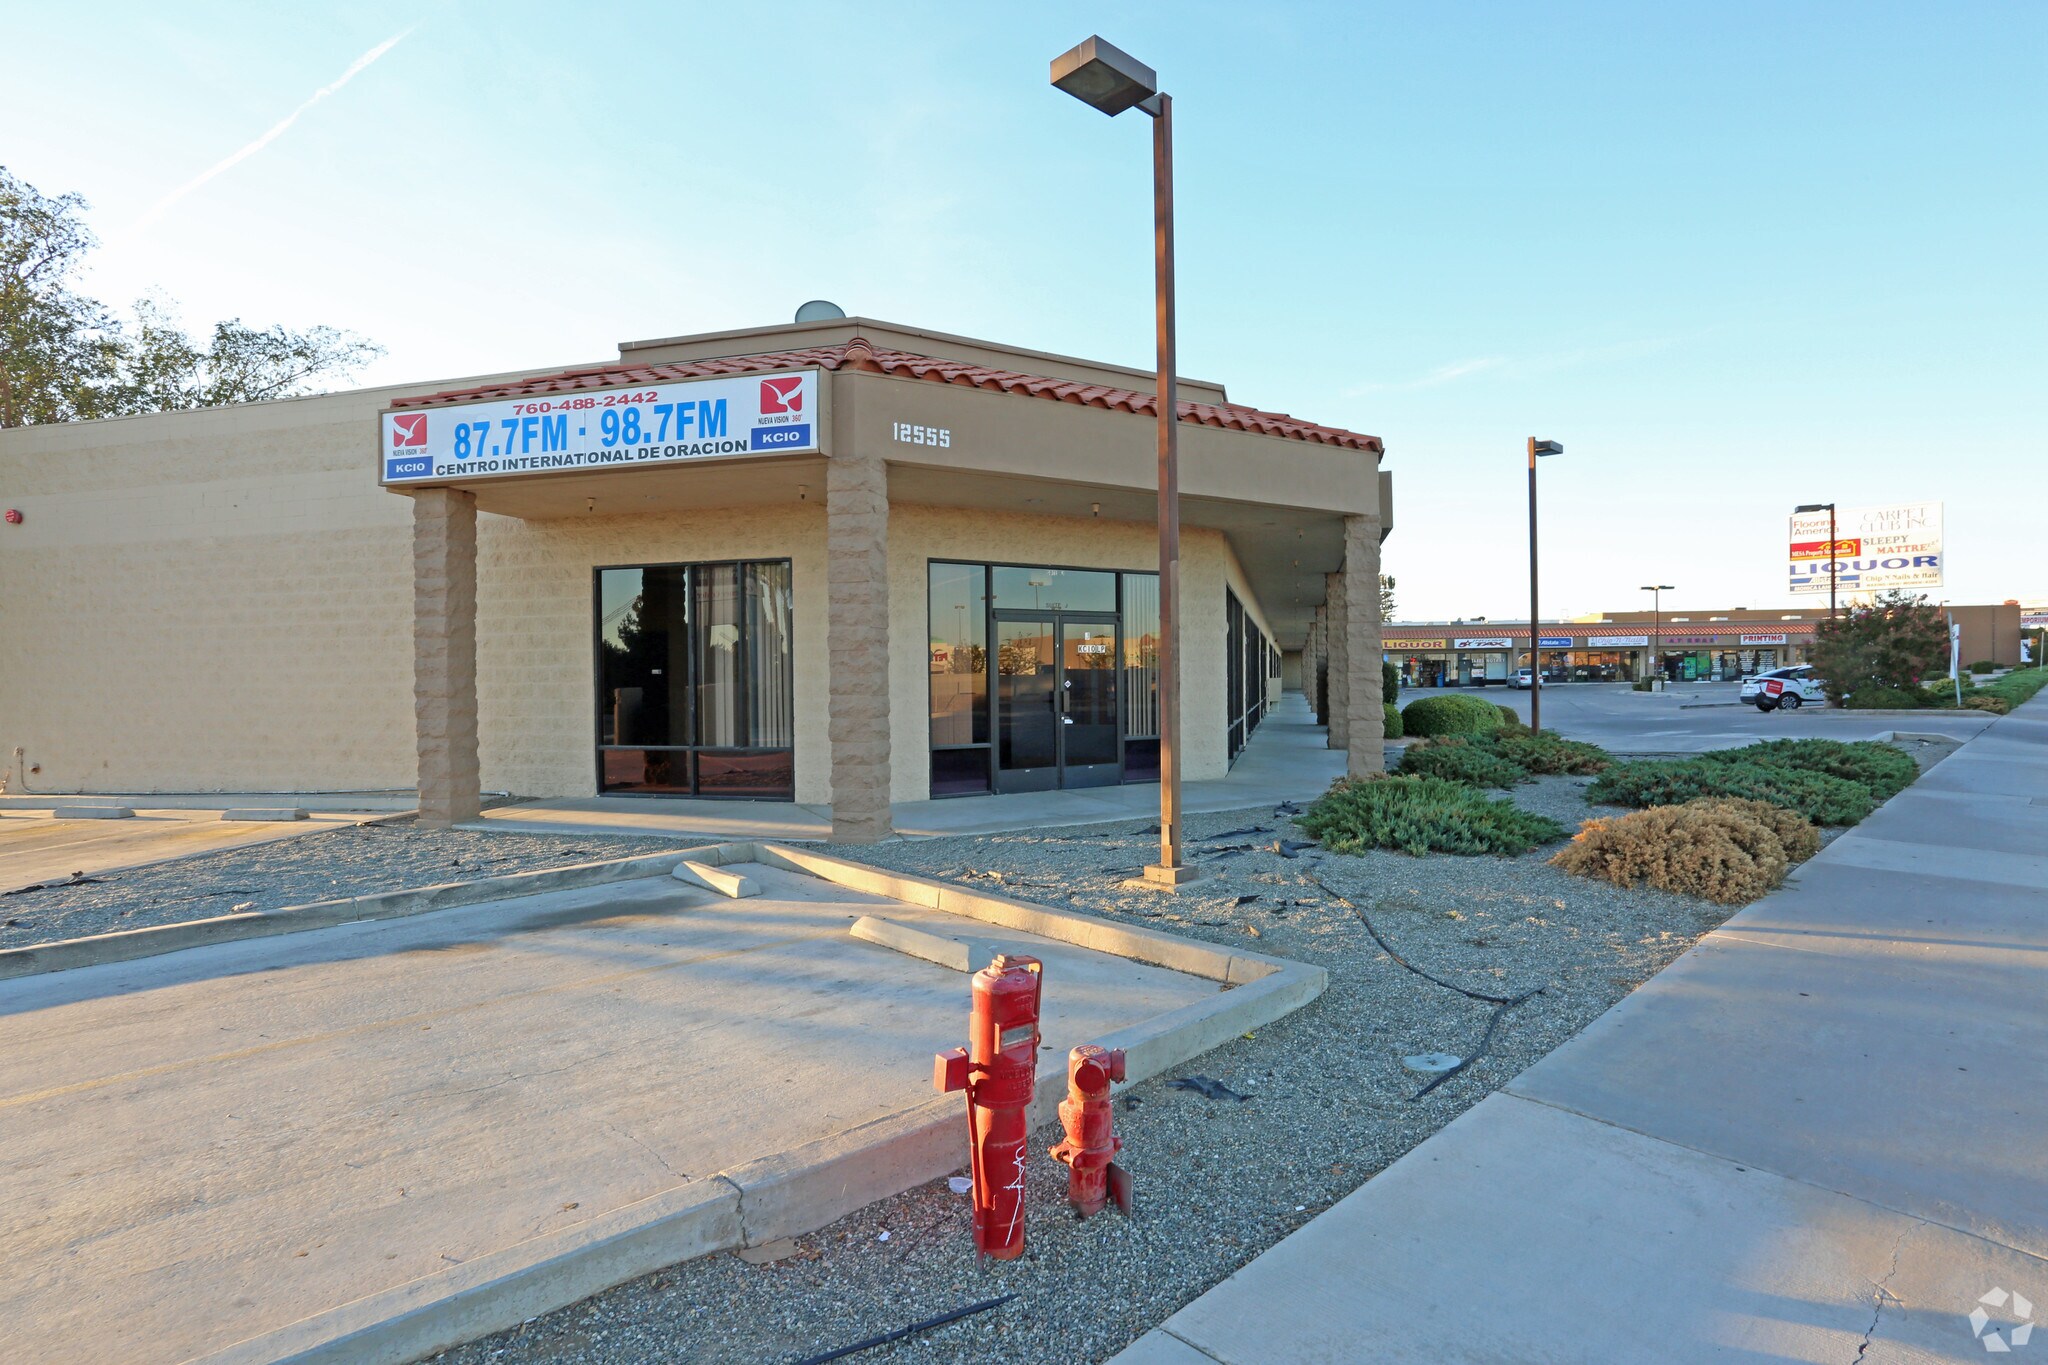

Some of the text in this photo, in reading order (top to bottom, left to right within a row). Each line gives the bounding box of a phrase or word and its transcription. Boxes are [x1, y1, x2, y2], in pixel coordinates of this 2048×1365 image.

[513, 391, 659, 415] 760-488-2442
[758, 416, 773, 425] NUEVA
[774, 415, 789, 424] VISION
[454, 414, 568, 460] 87.7FM
[600, 398, 728, 448] 98.7FM
[893, 422, 950, 448] 12555
[762, 431, 801, 444] KCIO
[435, 439, 748, 476] CENTRO INTERNATIONAL DE ORACION
[395, 462, 426, 474] KCIO
[1863, 535, 1909, 546] SLEEPY
[1824, 547, 1852, 555] Maagement
[1790, 555, 1938, 576] LIQUOR
[1865, 574, 1883, 583] Chip
[1743, 634, 1784, 643] PRINTING
[1384, 641, 1443, 649] LIQUOR
